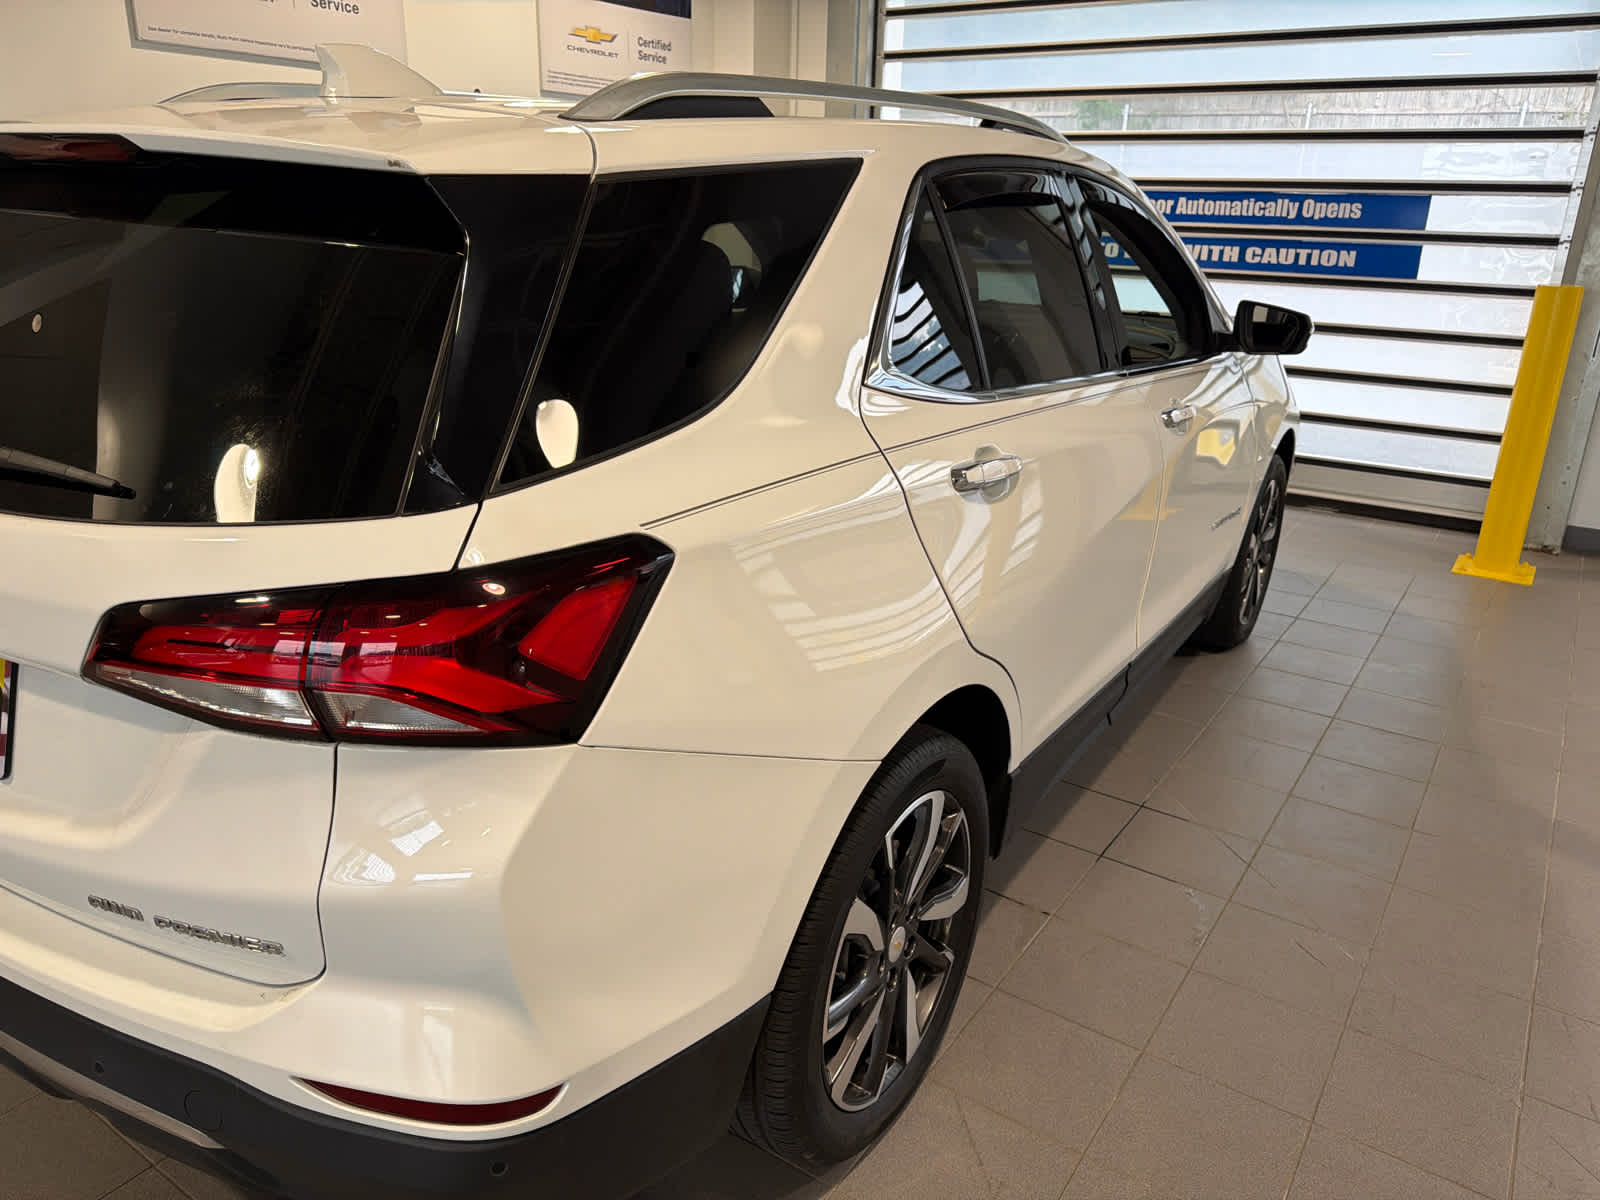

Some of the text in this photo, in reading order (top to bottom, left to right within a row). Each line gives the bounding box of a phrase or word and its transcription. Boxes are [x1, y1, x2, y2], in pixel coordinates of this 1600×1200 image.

[566, 44, 619, 59] CHEVROLET
[637, 36, 672, 52] Certified
[637, 50, 667, 64] Service
[1175, 196, 1299, 219] Automatically
[1301, 198, 1362, 220] Opens
[1245, 246, 1357, 268] CAUTION
